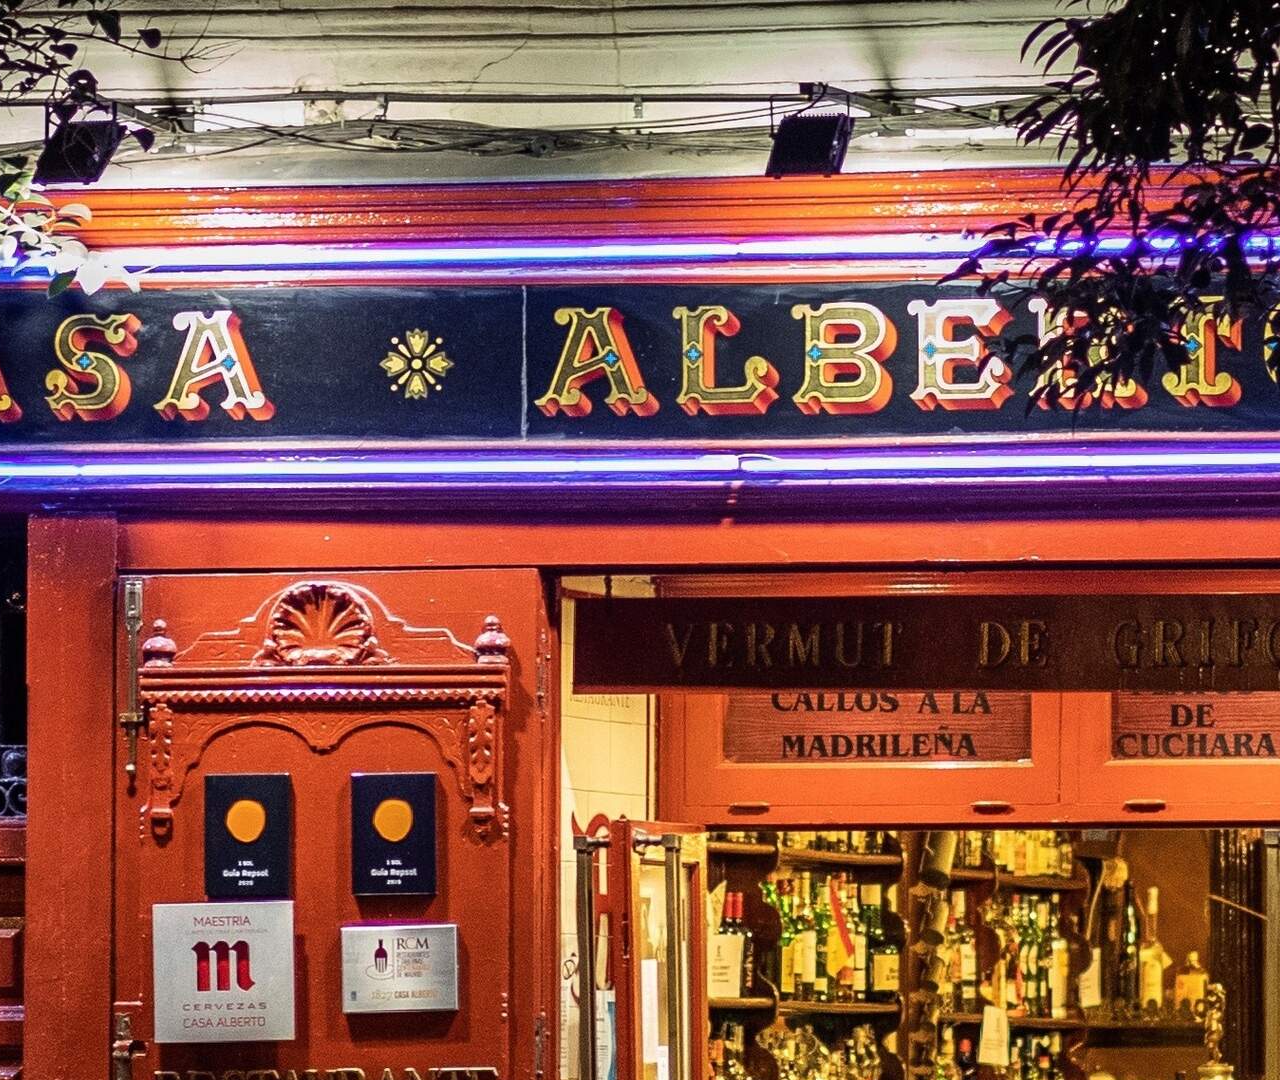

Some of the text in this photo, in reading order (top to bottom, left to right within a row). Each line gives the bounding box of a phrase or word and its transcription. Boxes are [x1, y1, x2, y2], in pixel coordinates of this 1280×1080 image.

[666, 621, 904, 668] VERMUT
[977, 620, 1049, 668] DE
[772, 691, 992, 716] CALLOS A LA
[1170, 703, 1216, 728] DE
[782, 732, 977, 759] MADRILEÑA
[1116, 732, 1277, 758] CUCHARA
[241, 868, 269, 878] Repsol
[390, 867, 417, 877] Repsol
[396, 937, 429, 950] RCM
[182, 1002, 268, 1012] CERVEZAS
[183, 1016, 266, 1029] CASA ALBERTO
